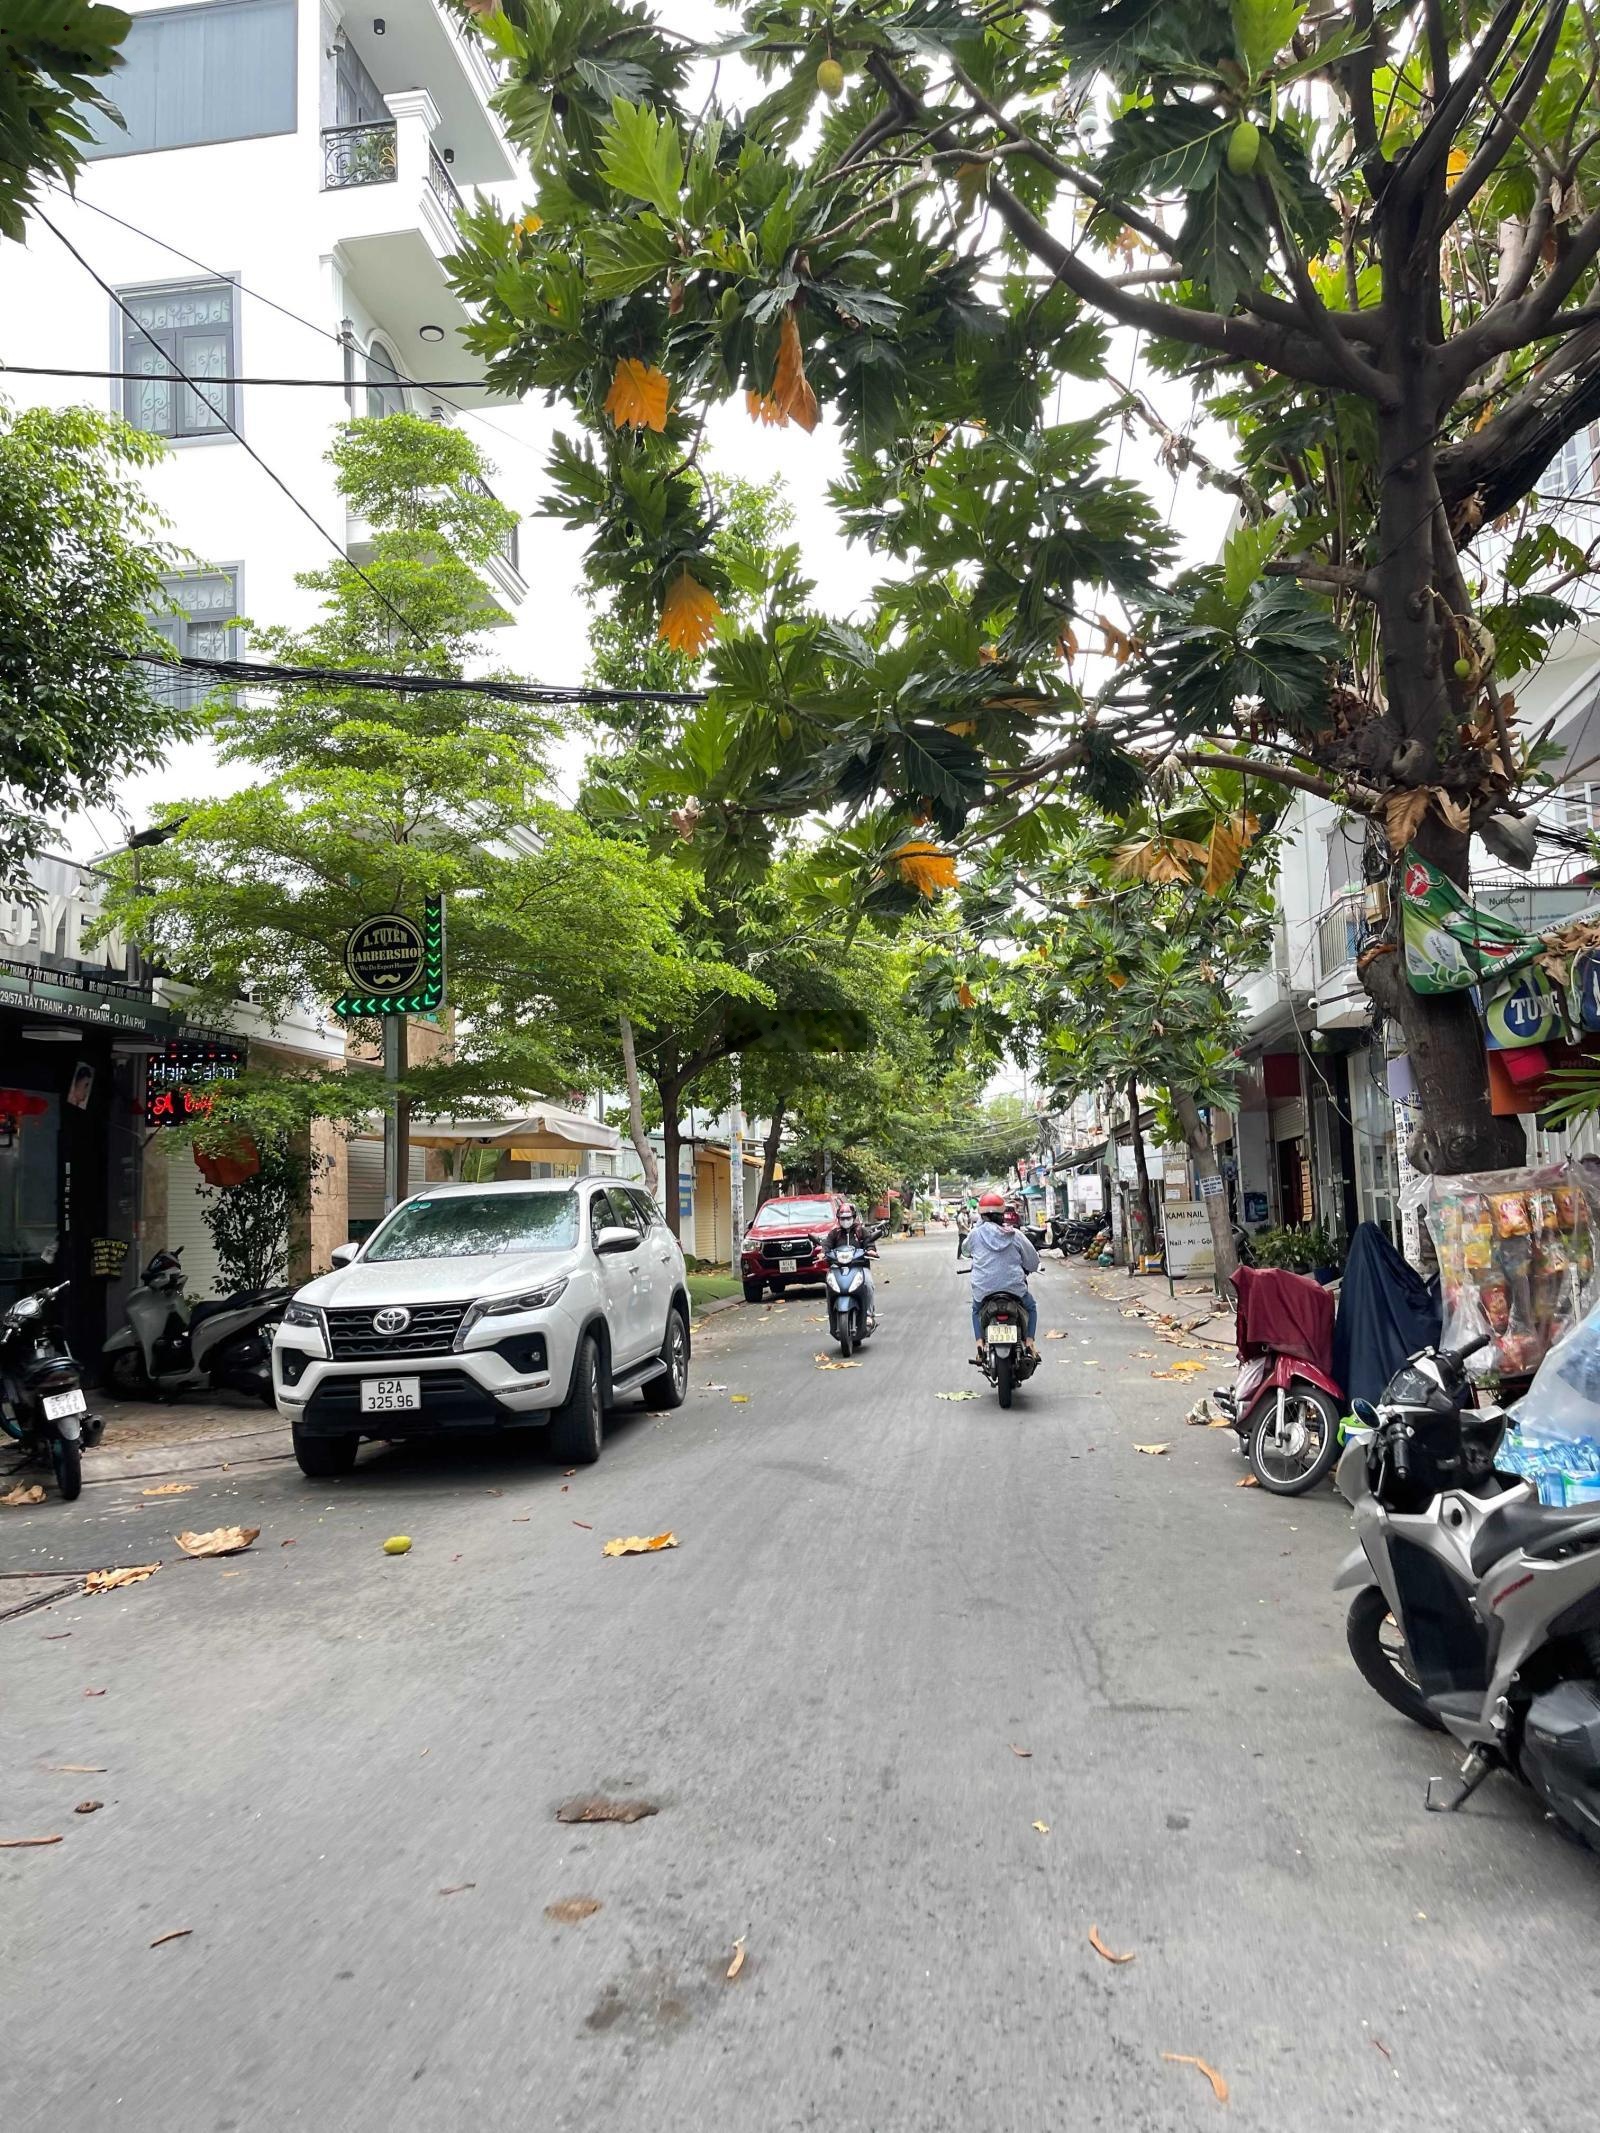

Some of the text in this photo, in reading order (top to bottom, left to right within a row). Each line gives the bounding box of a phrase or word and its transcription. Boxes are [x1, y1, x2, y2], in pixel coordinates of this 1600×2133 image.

[346, 947, 425, 963] BARBERSHOP
[153, 1062, 236, 1082] Hair Salon
[1166, 1210, 1205, 1220] KAMI NAIL
[377, 1380, 403, 1395] 62A
[368, 1394, 414, 1410] 325.96
